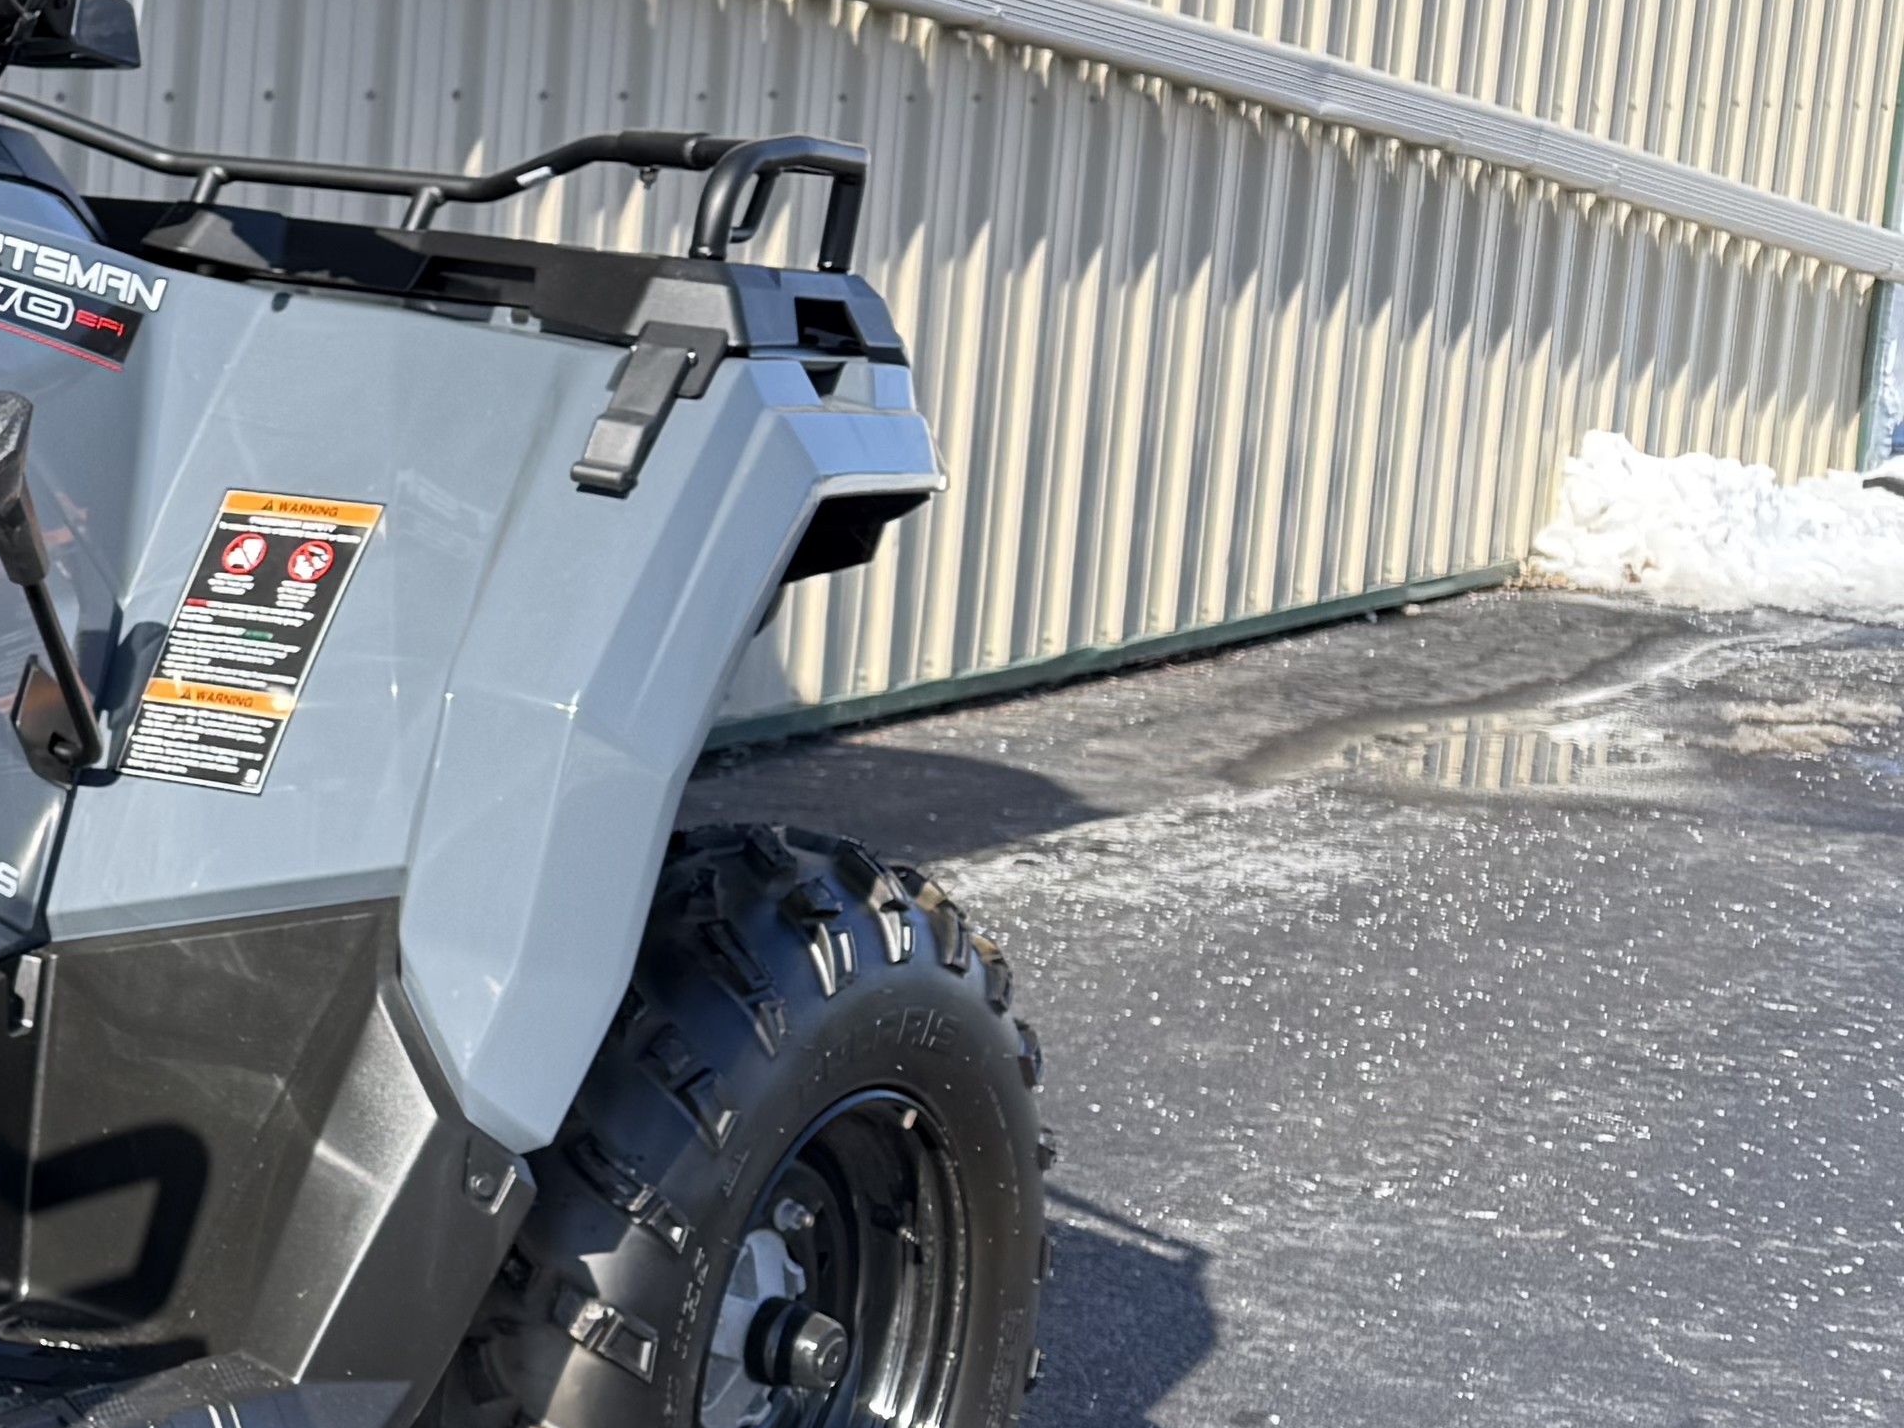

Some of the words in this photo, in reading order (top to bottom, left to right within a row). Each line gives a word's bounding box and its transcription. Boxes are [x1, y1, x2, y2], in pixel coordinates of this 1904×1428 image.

[74, 309, 126, 338] EFI
[278, 501, 339, 518] WARNING
[195, 690, 254, 707] WARNING
